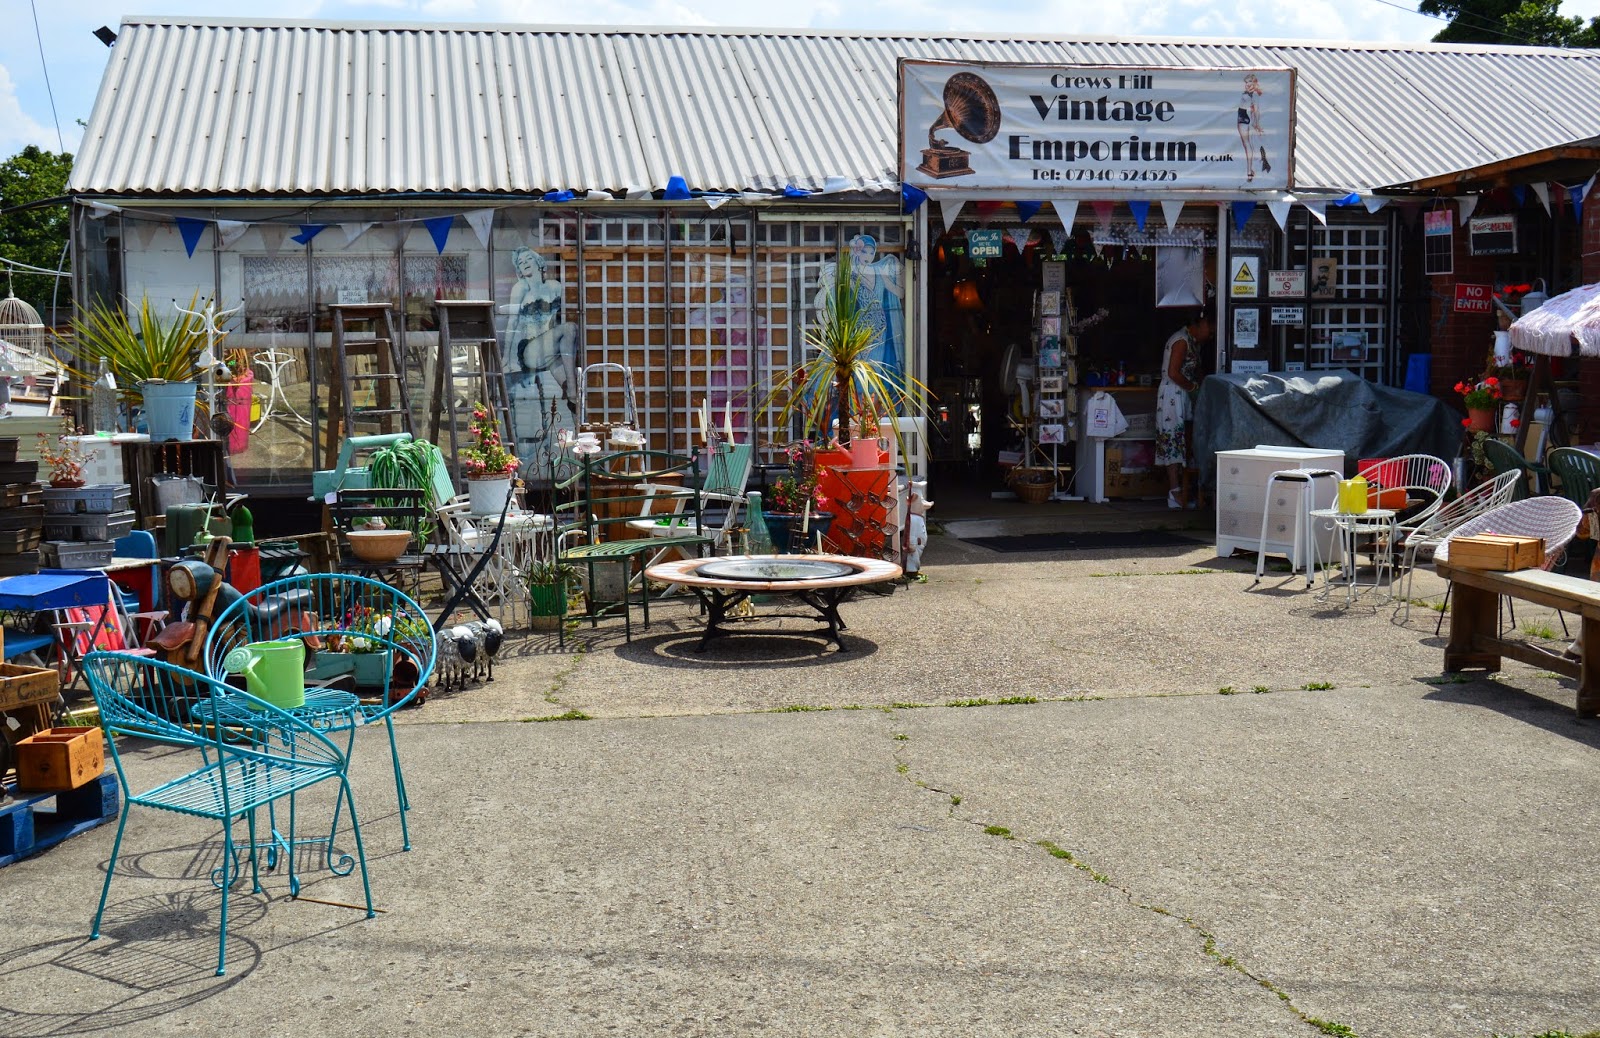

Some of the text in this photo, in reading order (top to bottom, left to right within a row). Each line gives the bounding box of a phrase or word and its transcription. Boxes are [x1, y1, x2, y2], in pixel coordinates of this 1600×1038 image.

[1050, 73, 1153, 90] Crews Hill
[1029, 94, 1176, 123] Vintage
[1008, 134, 1197, 162] Emporium
[1030, 168, 1179, 182] Tel: 07940 524525
[971, 232, 999, 243] Come In
[972, 246, 1000, 256] OPEN
[1319, 287, 1335, 296] YOU
[1466, 286, 1483, 297] NO
[1456, 298, 1490, 310] ENTRY
